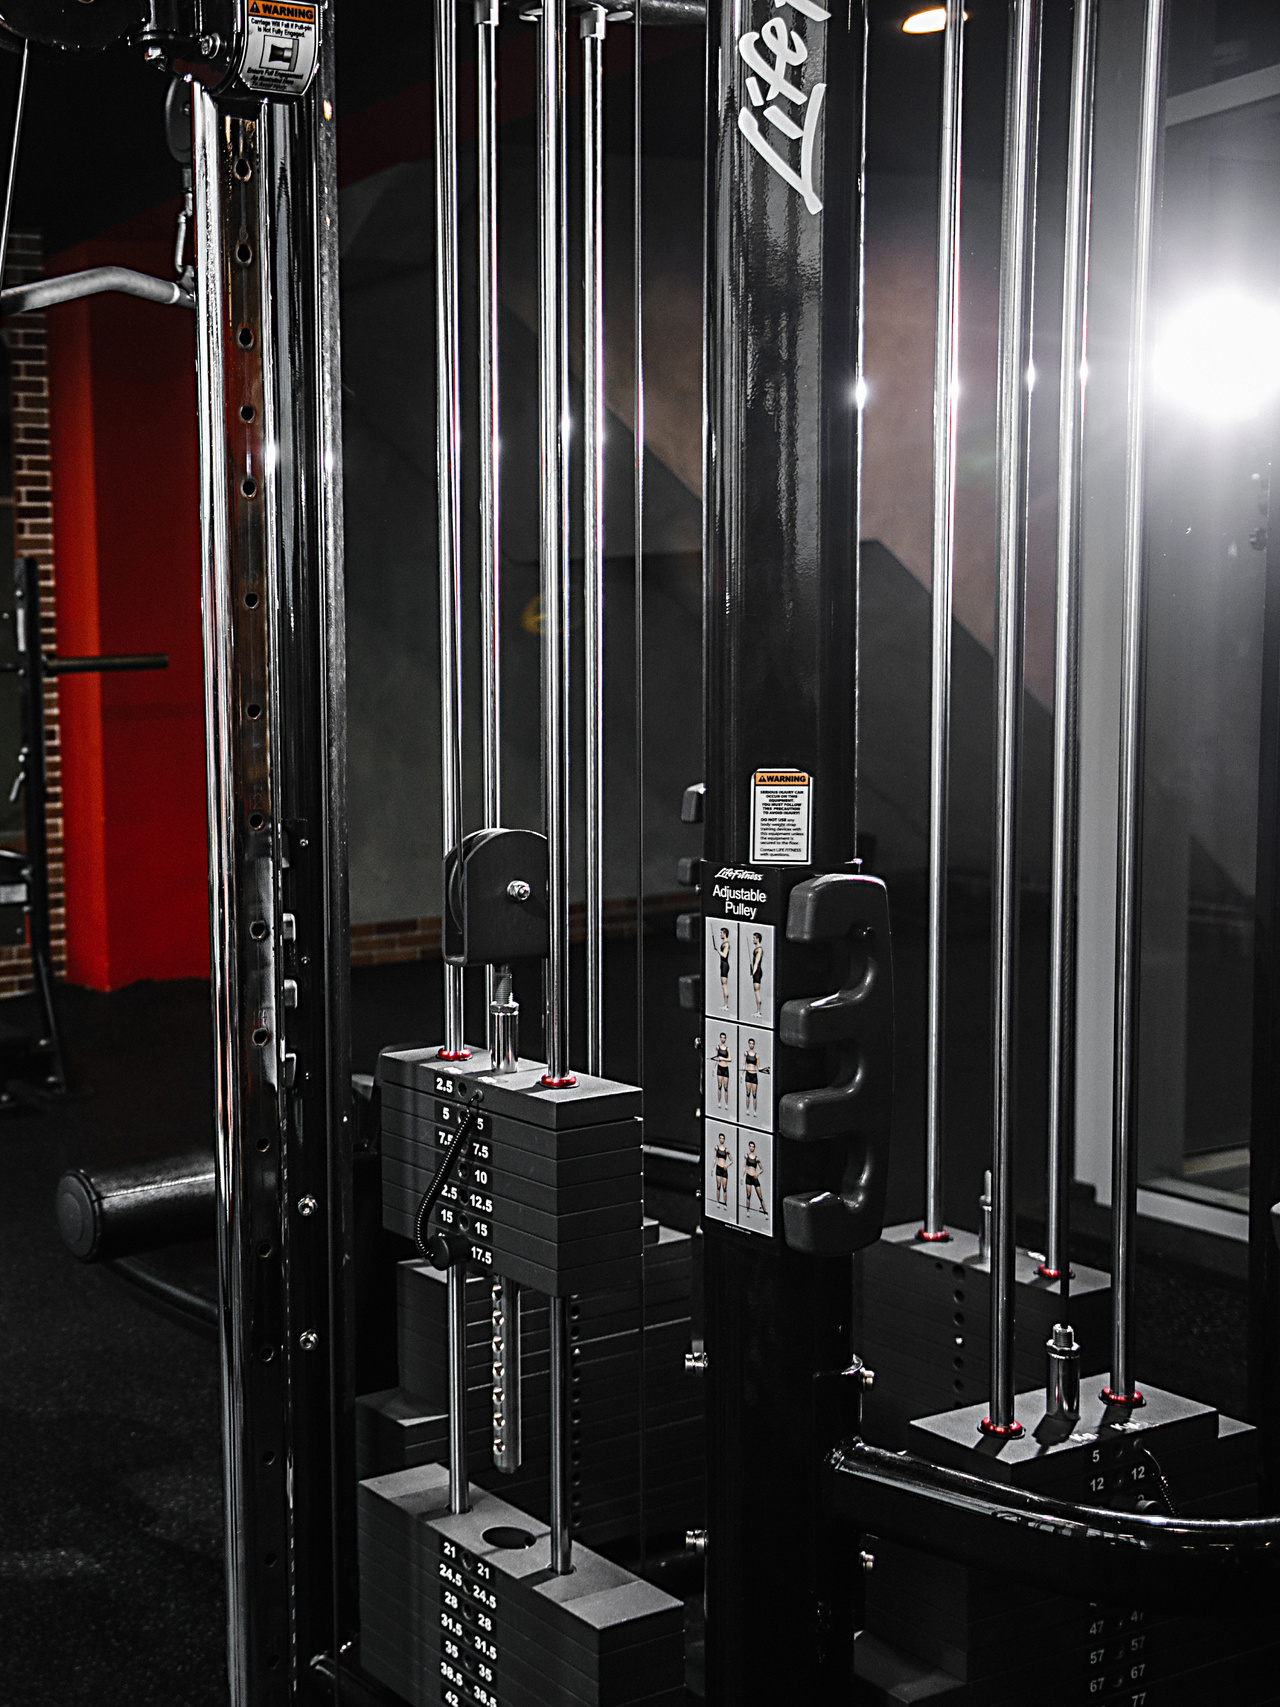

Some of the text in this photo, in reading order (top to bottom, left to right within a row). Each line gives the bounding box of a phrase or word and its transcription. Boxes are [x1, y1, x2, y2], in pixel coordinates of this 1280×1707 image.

[262, 4, 314, 20] WARNING
[251, 18, 271, 27] Carriage
[272, 28, 283, 36] Fully
[766, 775, 807, 783] WARNING
[712, 884, 767, 903] Adjustable
[725, 901, 757, 920] Pulley
[436, 1077, 453, 1093] 2.5
[442, 1107, 484, 1130] 5 5
[473, 1142, 489, 1158] 7.5
[474, 1169, 487, 1184] 10
[441, 1184, 493, 1212] 2.5 12.5
[441, 1209, 488, 1236] 15 15
[471, 1246, 492, 1264] 17.5
[1092, 1450, 1100, 1463] 5
[1090, 1466, 1145, 1491] 12 12
[443, 1542, 490, 1579] 21 21
[439, 1563, 496, 1609] 24.5 24.5
[444, 1591, 492, 1631] 28 28
[441, 1613, 497, 1660] 31.5 31.5
[1089, 1620, 1104, 1635] 47
[1090, 1635, 1146, 1664] 57 57
[445, 1640, 492, 1682] 35 35
[440, 1662, 497, 1707] 38.5 38.5
[1089, 1663, 1146, 1693] 67 67
[445, 1690, 459, 1707] 42
[1131, 1692, 1147, 1707] 77
